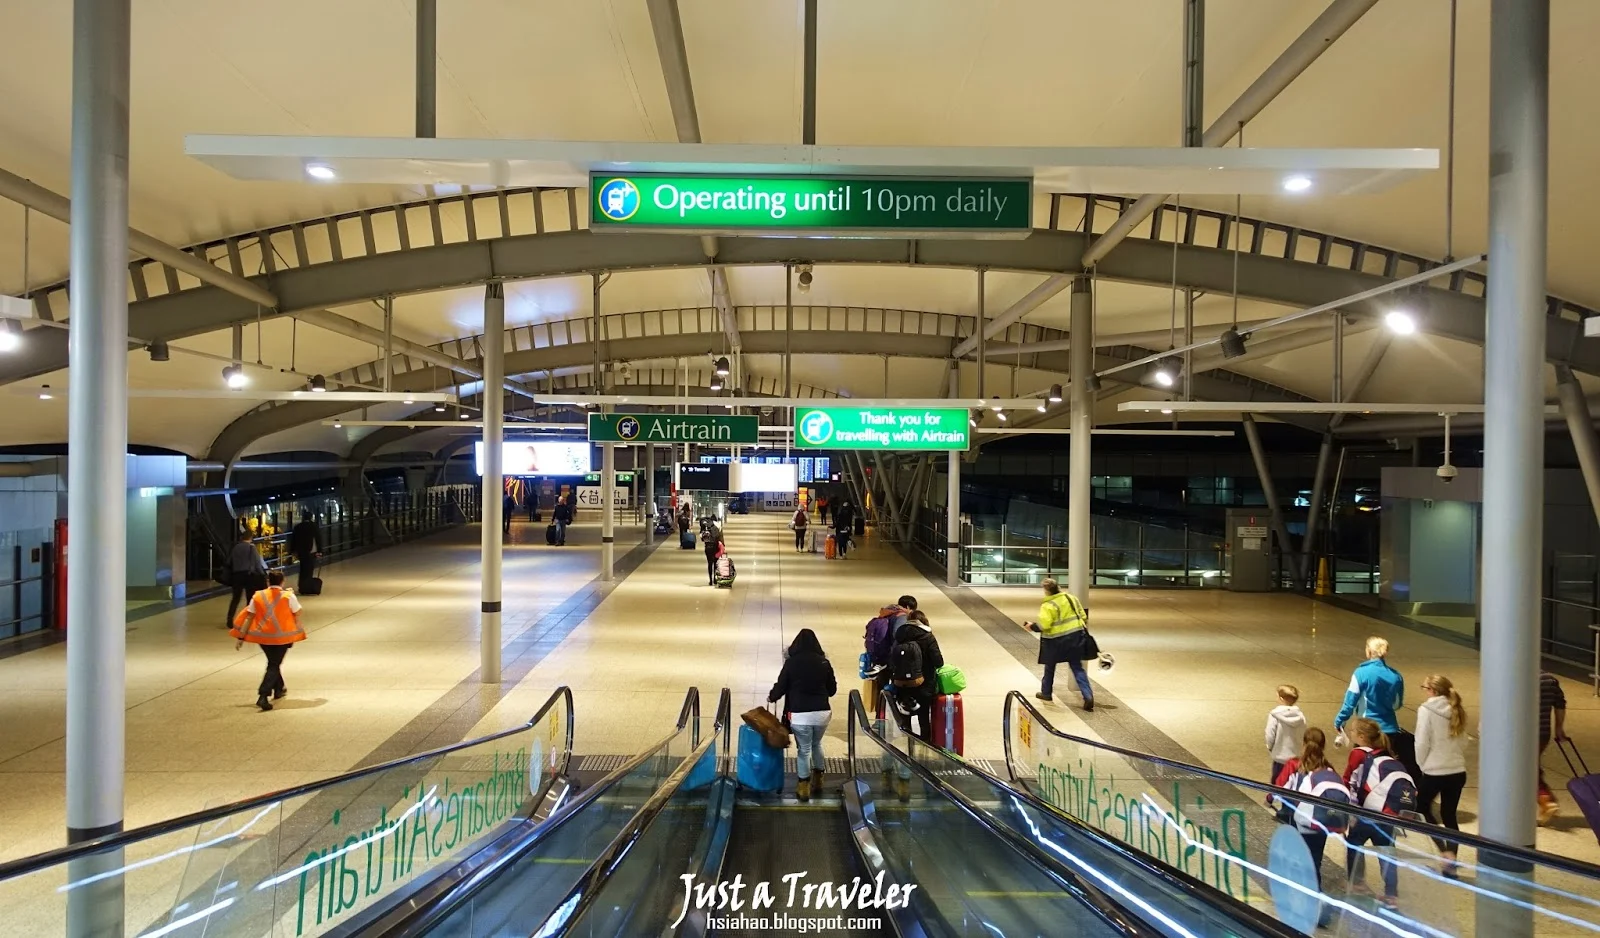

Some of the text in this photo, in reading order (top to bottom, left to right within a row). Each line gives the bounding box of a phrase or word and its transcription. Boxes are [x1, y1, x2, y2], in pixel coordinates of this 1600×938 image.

[653, 184, 1008, 220] Operating until 10pm daily
[859, 411, 942, 429] Thank you for
[648, 418, 732, 441] Airtrain
[835, 427, 965, 445] travelling with Airtrain
[772, 491, 787, 501] Lift
